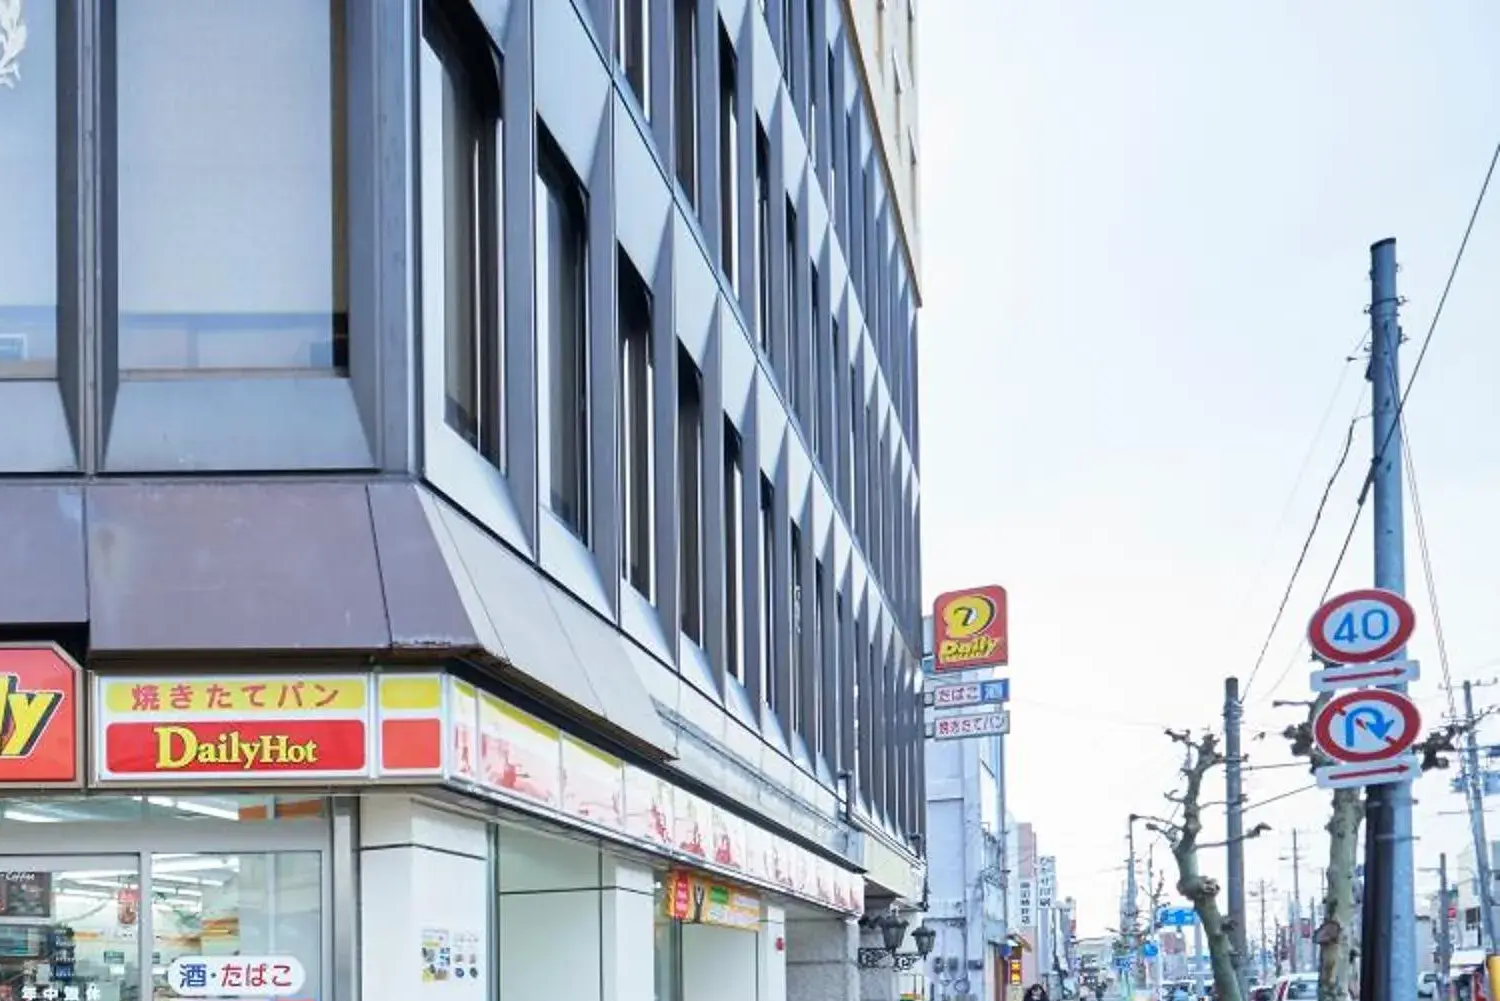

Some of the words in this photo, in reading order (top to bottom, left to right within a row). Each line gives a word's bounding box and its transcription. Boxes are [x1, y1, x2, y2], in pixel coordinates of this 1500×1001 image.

[1333, 608, 1390, 643] 40
[131, 681, 340, 712] 焼きたてパン
[938, 686, 978, 703] たばこ
[153, 723, 318, 769] DailyHot
[179, 963, 293, 988] 酒・たばこ
[21, 982, 101, 1001] 年中無休
